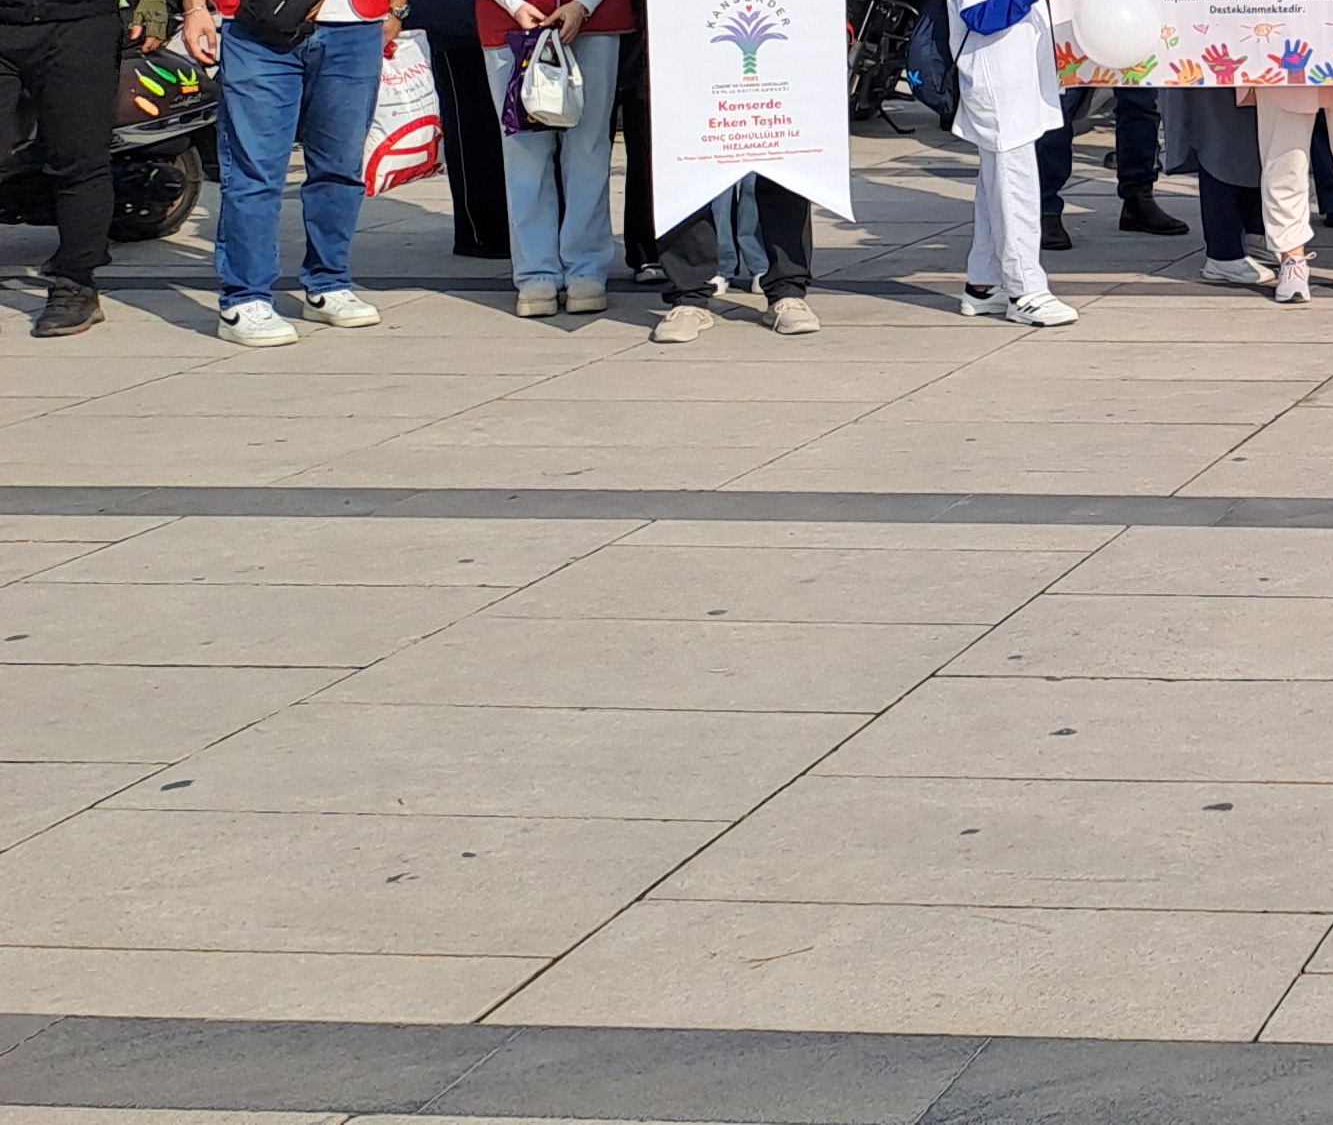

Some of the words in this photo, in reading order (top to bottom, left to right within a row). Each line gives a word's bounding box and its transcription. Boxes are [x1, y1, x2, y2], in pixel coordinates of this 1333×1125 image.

[1209, 4, 1306, 15] Desteklenmektedir.
[718, 99, 783, 112] Kanserde
[708, 116, 747, 129] Erken
[750, 114, 793, 129] Teşhis
[722, 140, 780, 151] HIZLANACAK
